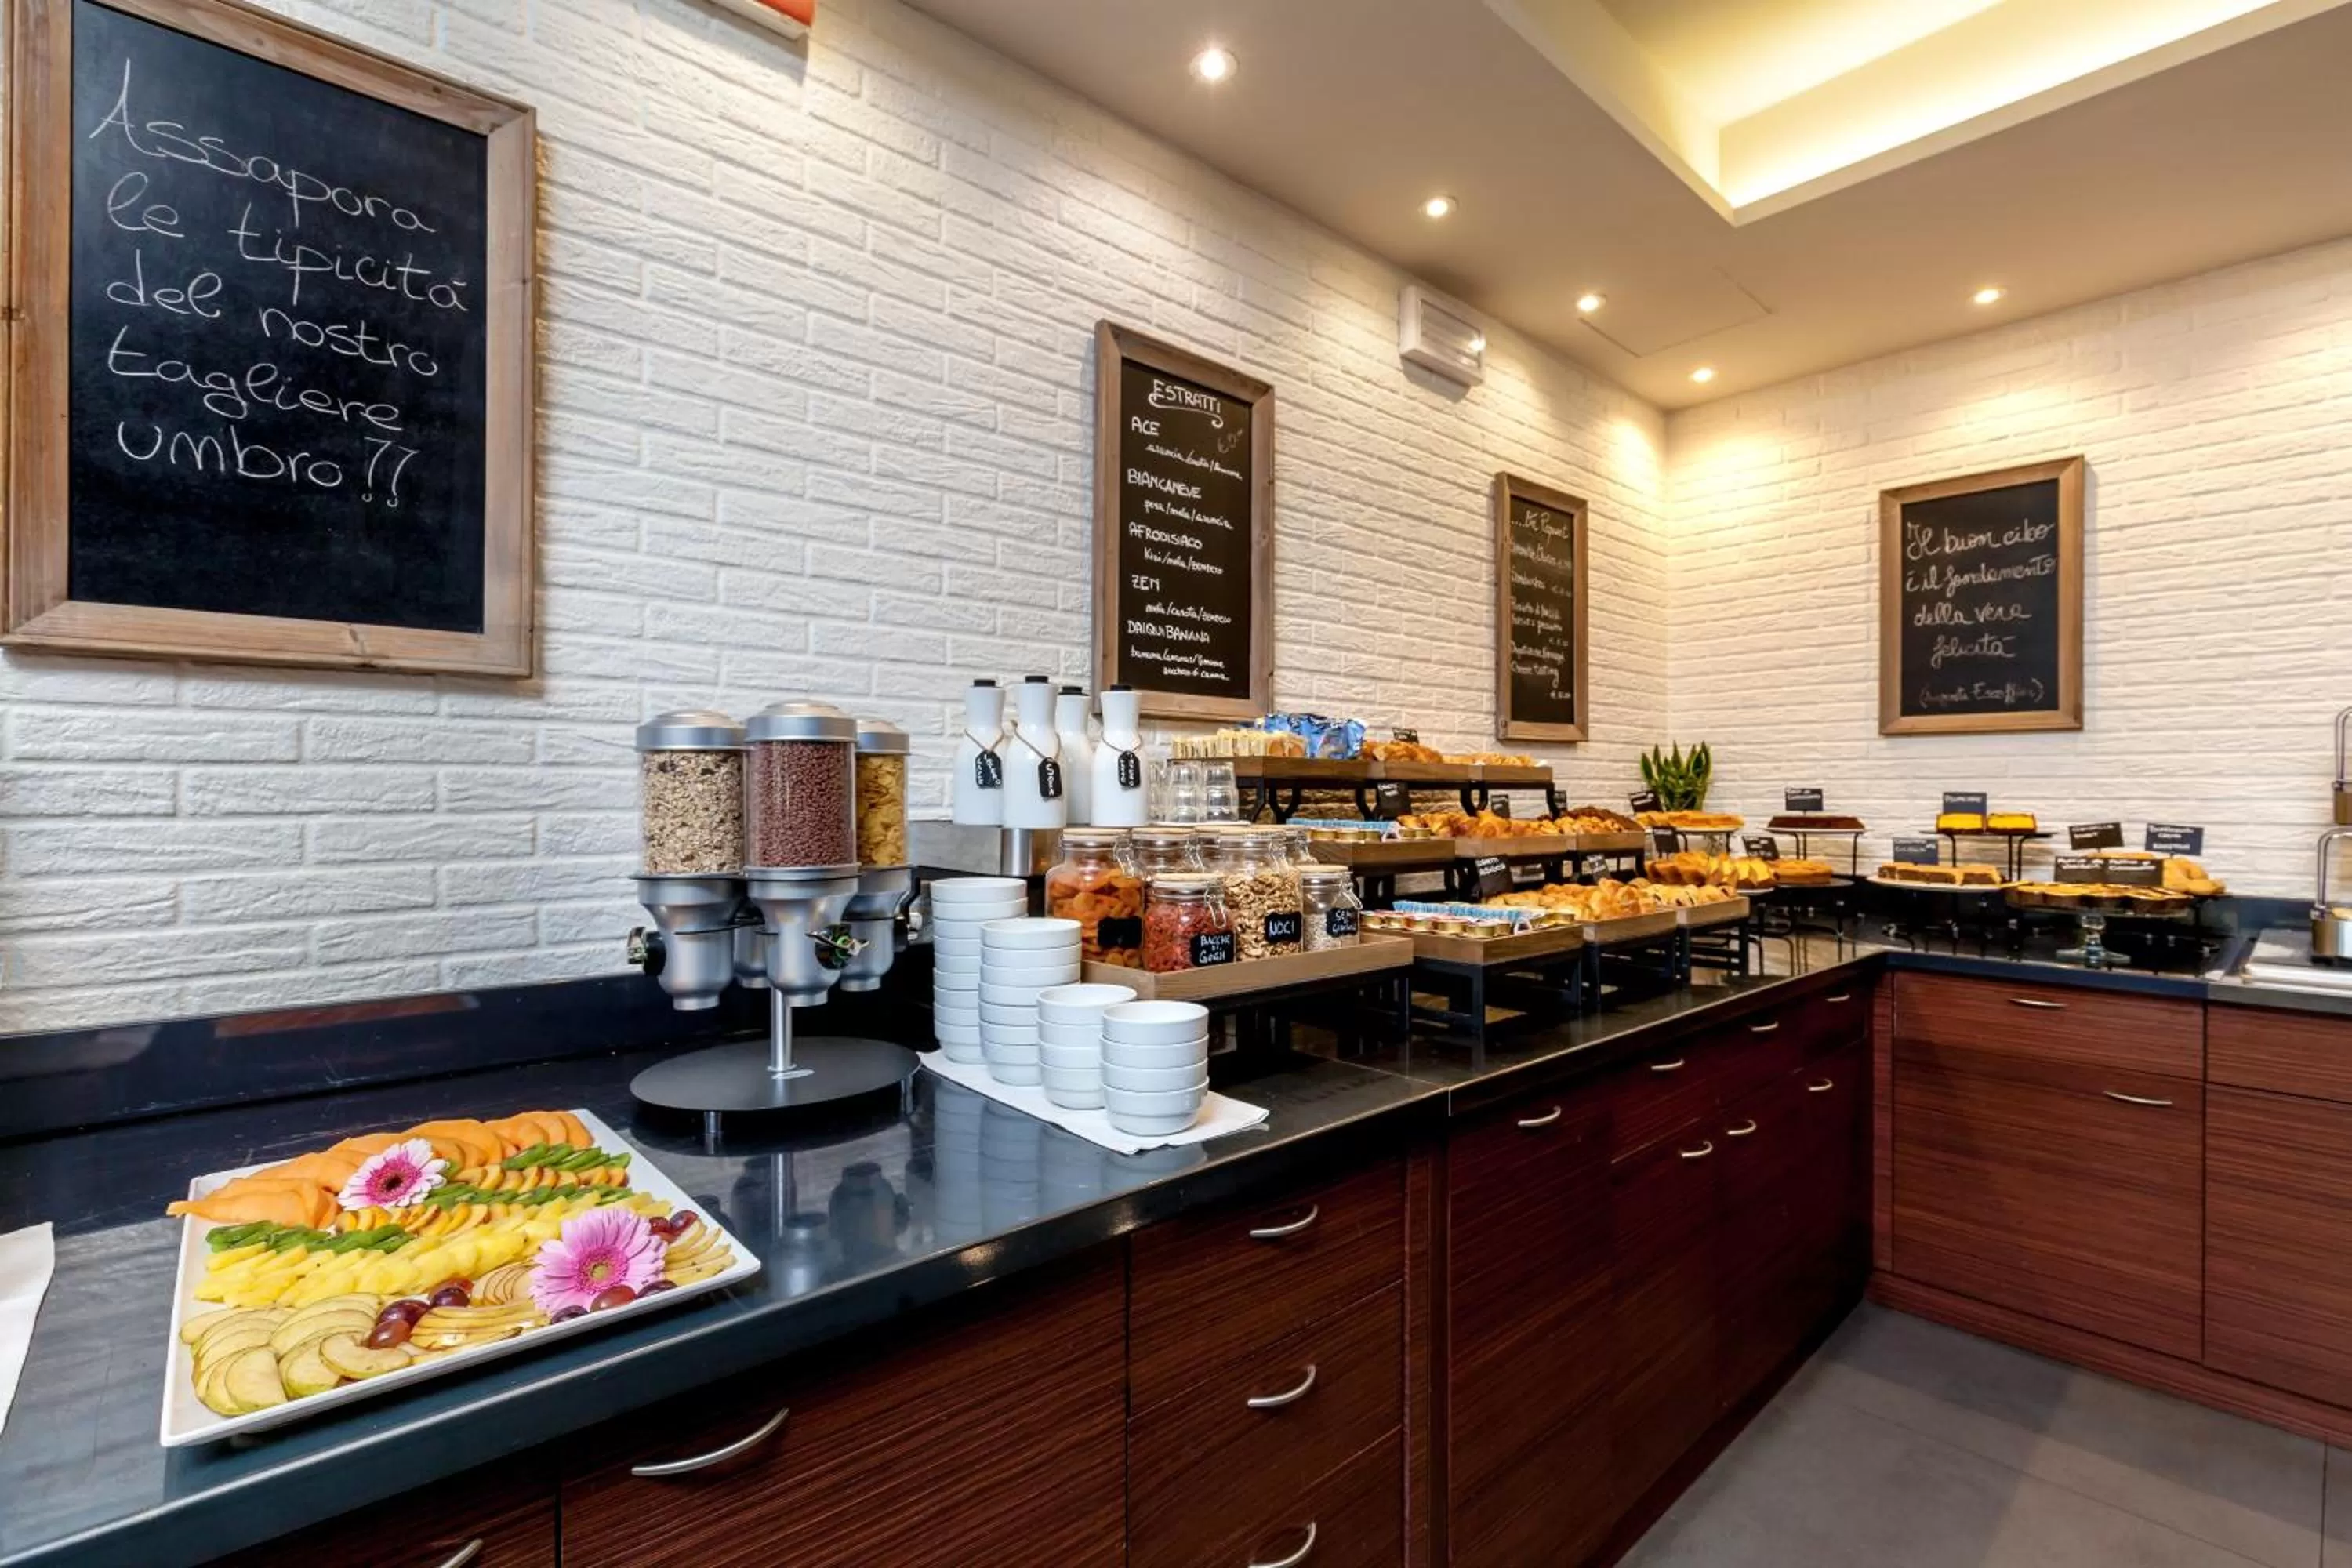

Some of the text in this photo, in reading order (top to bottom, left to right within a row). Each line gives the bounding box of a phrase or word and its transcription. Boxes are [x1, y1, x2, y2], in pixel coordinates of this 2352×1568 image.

[89, 58, 436, 233] Assapora
[106, 249, 437, 376] del nostro
[107, 325, 403, 431] tagliere
[1152, 379, 1221, 414] ESTRATTI
[1131, 416, 1161, 436] ACE
[1127, 468, 1202, 499] BIANCANEVE
[1129, 521, 1203, 550] AFRODISIACO
[1944, 527, 2000, 554] buon
[2003, 518, 2055, 545] cibo
[1131, 575, 1160, 592] ZEN
[1944, 554, 2057, 597] fondamento
[1914, 601, 2032, 626] della vera
[1269, 919, 1294, 936] NOCI
